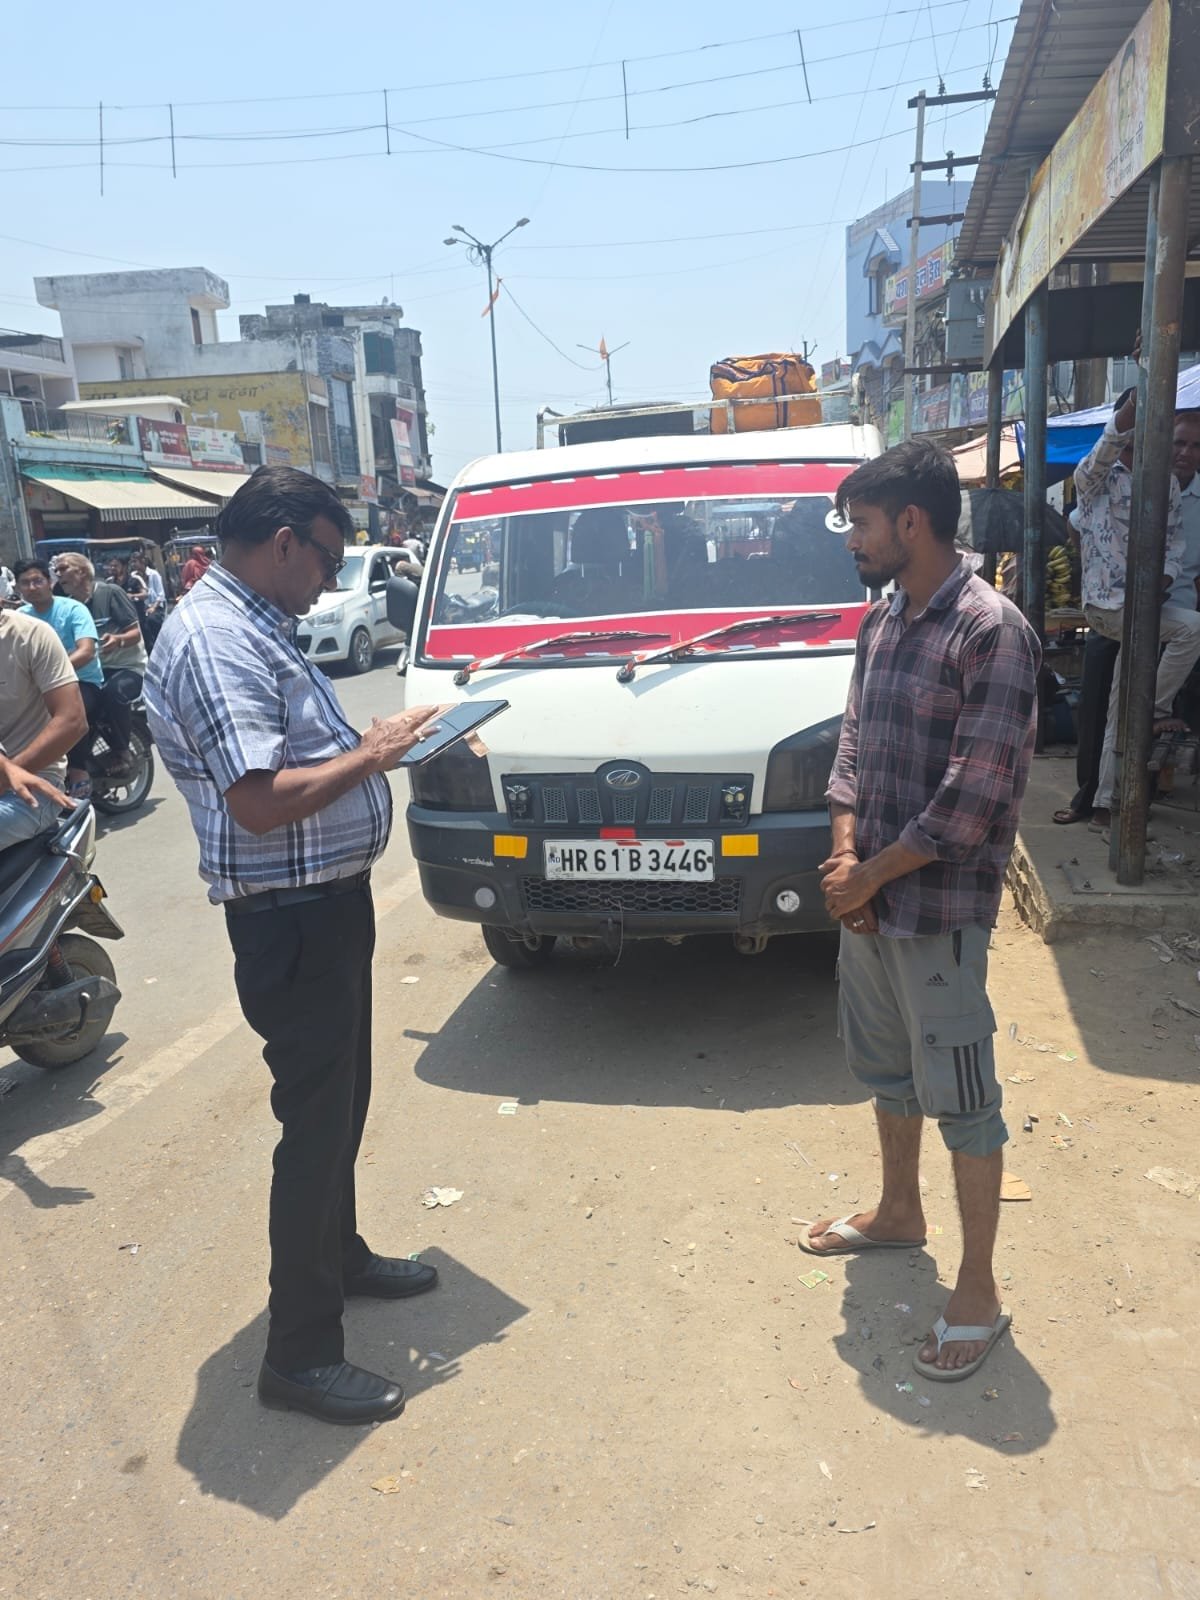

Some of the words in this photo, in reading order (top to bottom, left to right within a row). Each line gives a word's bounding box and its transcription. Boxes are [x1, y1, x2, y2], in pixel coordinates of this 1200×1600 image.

[561, 848, 588, 872] HR
[594, 848, 620, 872] 61
[629, 849, 642, 872] B
[648, 848, 707, 872] 3446
